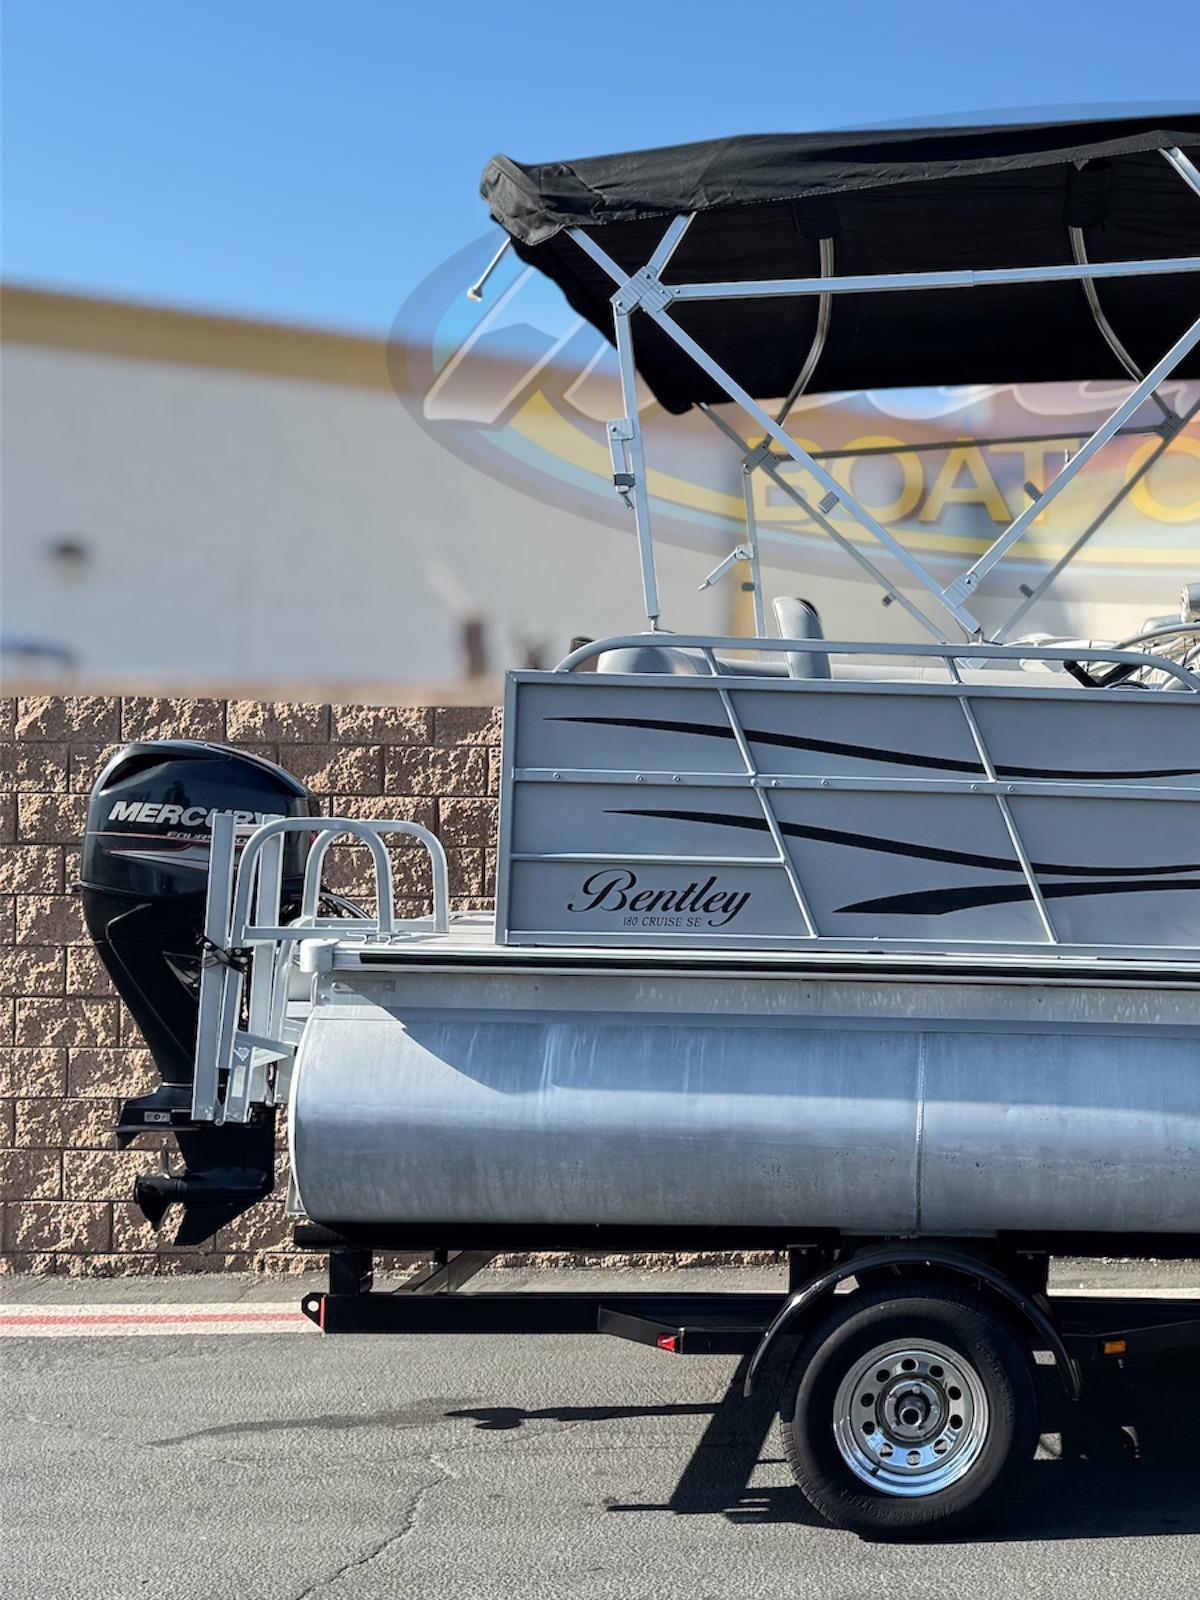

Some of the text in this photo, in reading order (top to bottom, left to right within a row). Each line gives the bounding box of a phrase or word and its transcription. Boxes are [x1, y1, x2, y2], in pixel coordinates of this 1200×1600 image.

[567, 868, 752, 927] Bentley
[623, 917, 702, 927] 180 CRUISE SE
